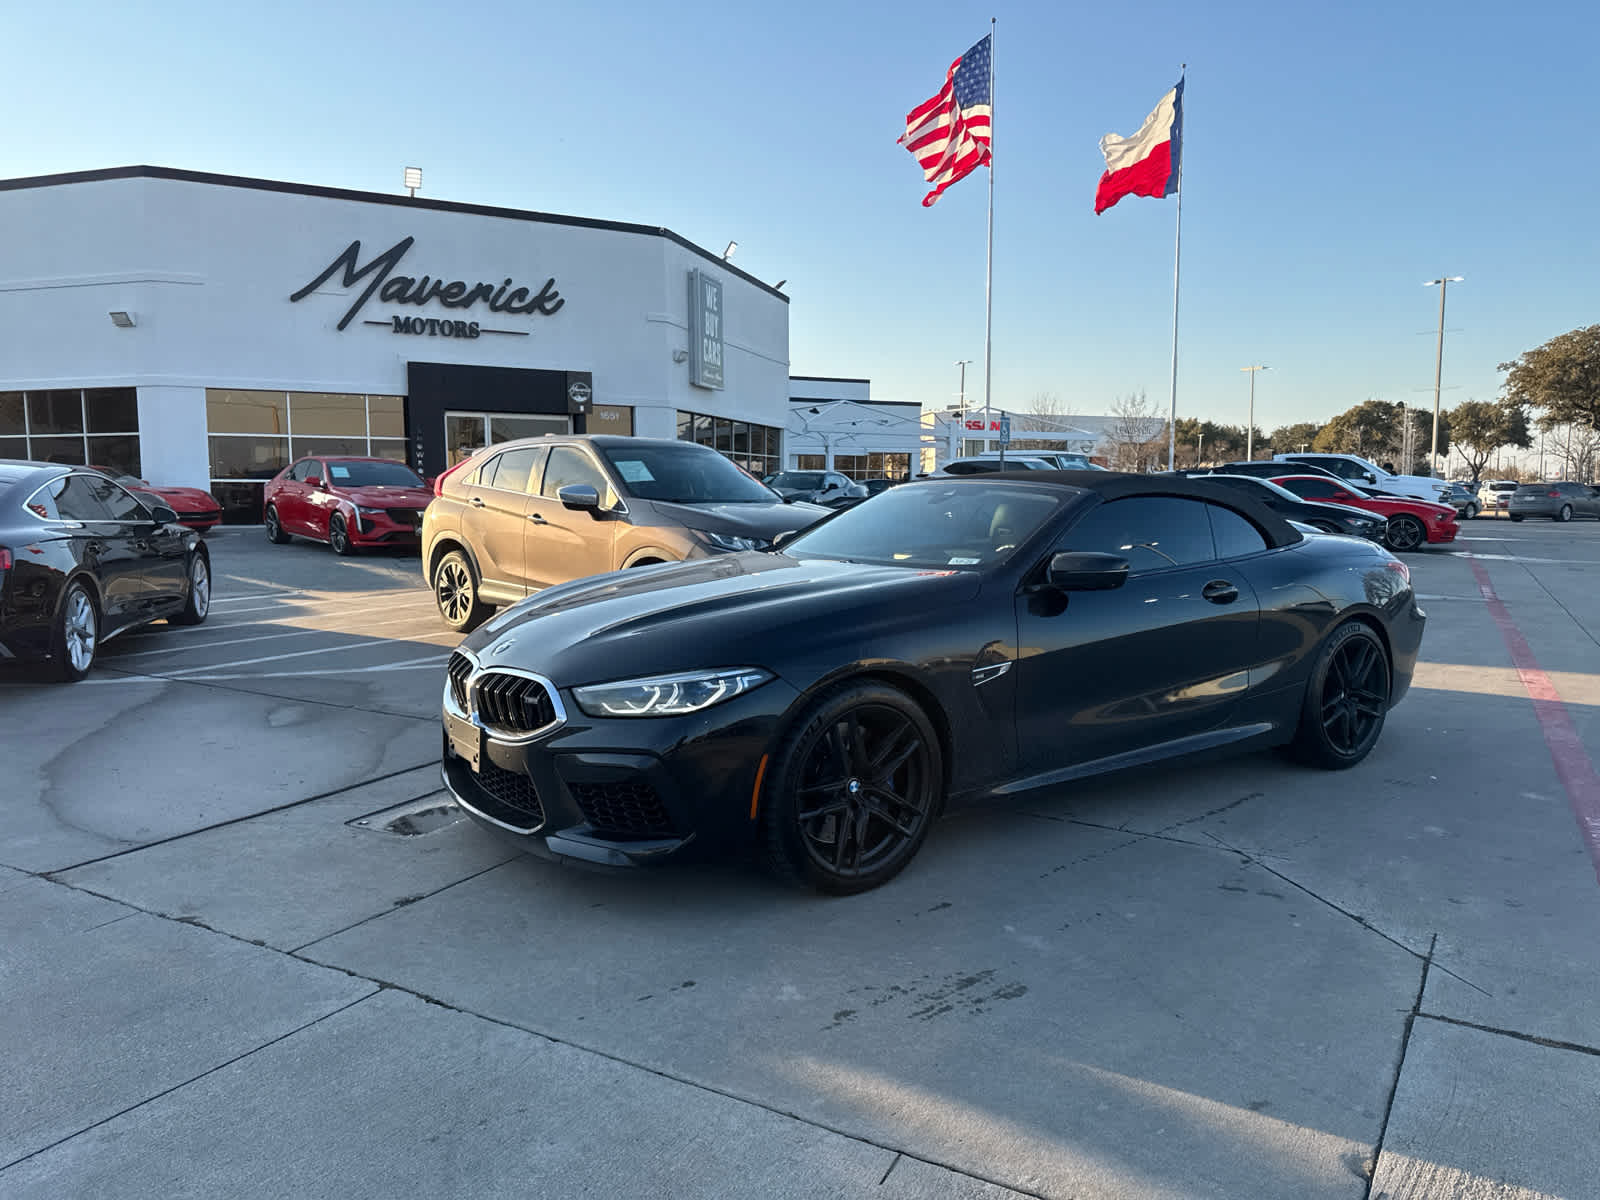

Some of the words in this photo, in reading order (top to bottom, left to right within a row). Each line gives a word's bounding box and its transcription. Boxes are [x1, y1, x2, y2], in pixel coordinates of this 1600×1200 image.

[290, 236, 565, 331] Maverick
[705, 282, 718, 311] WE
[392, 315, 481, 339] MOTORS
[703, 337, 721, 366] CARS
